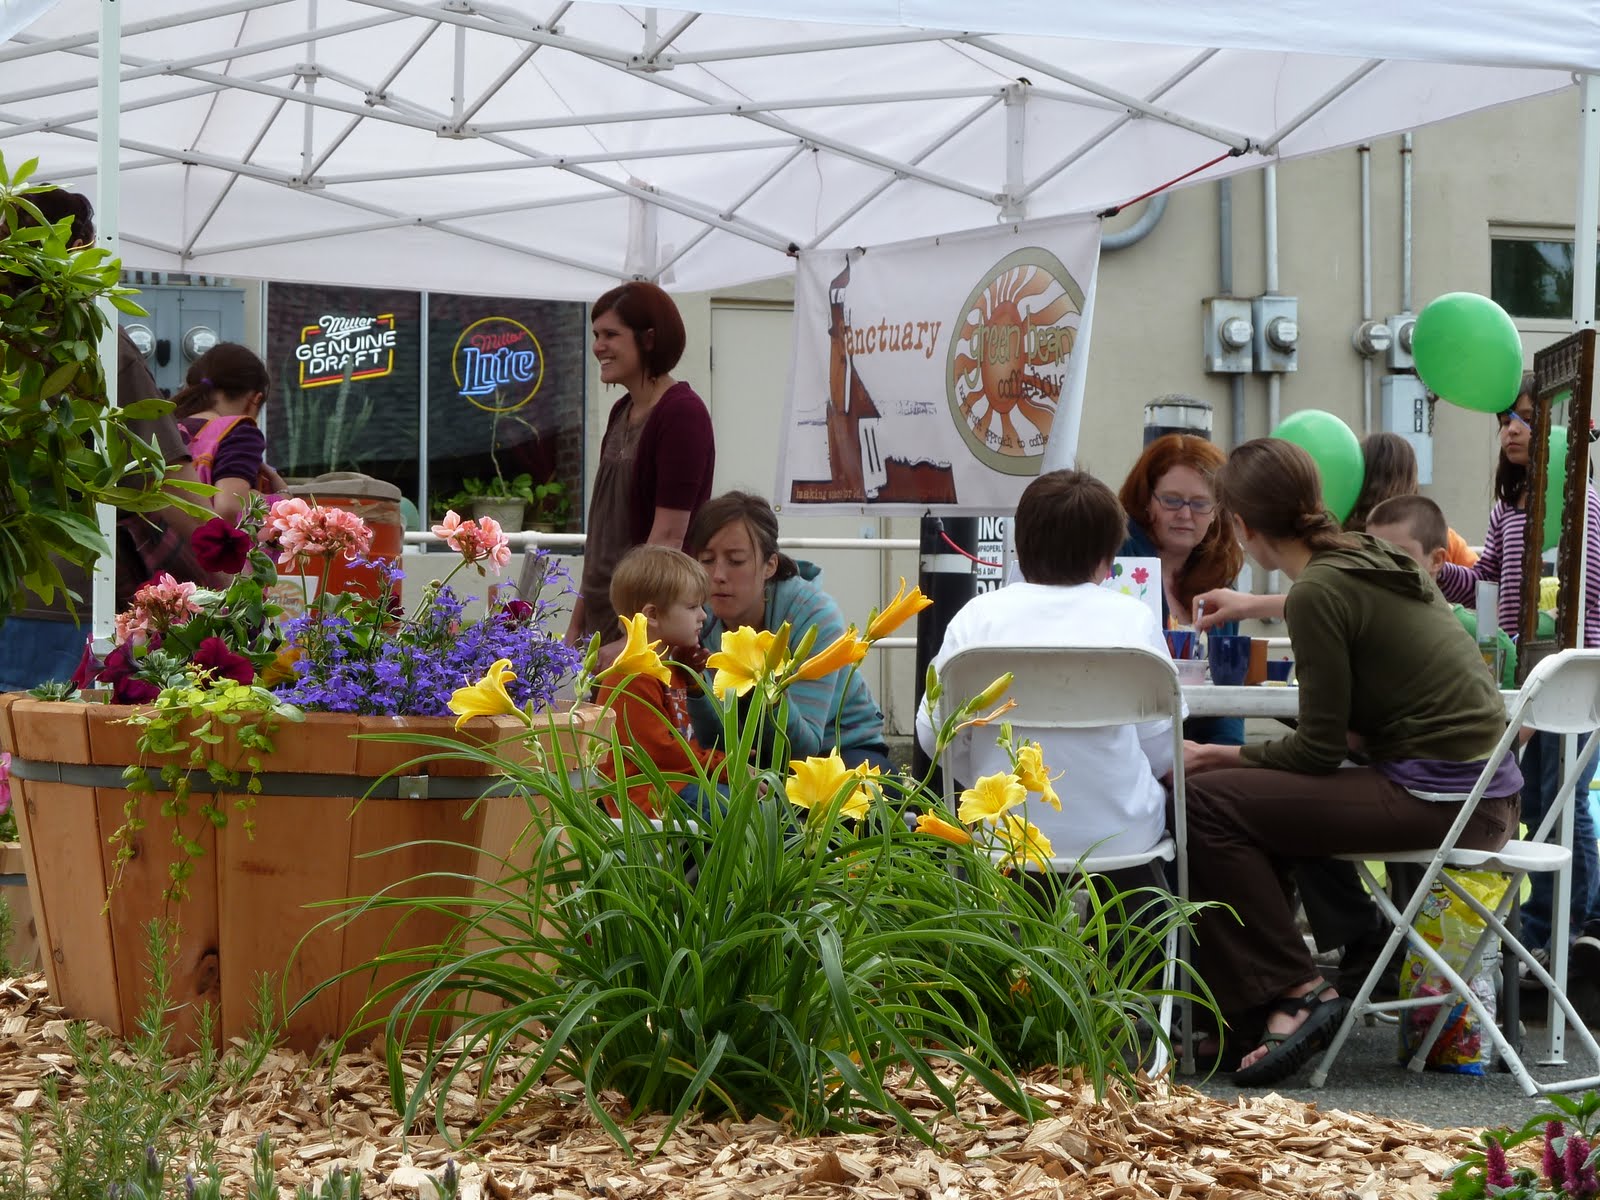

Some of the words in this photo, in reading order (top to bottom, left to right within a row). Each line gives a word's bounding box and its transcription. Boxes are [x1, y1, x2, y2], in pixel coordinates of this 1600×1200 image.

[318, 315, 376, 338] Miller
[295, 330, 397, 361] GENUINE
[470, 330, 526, 352] Miller
[964, 309, 1021, 390] green
[1025, 304, 1073, 367] bean
[308, 348, 382, 375] DRAFT
